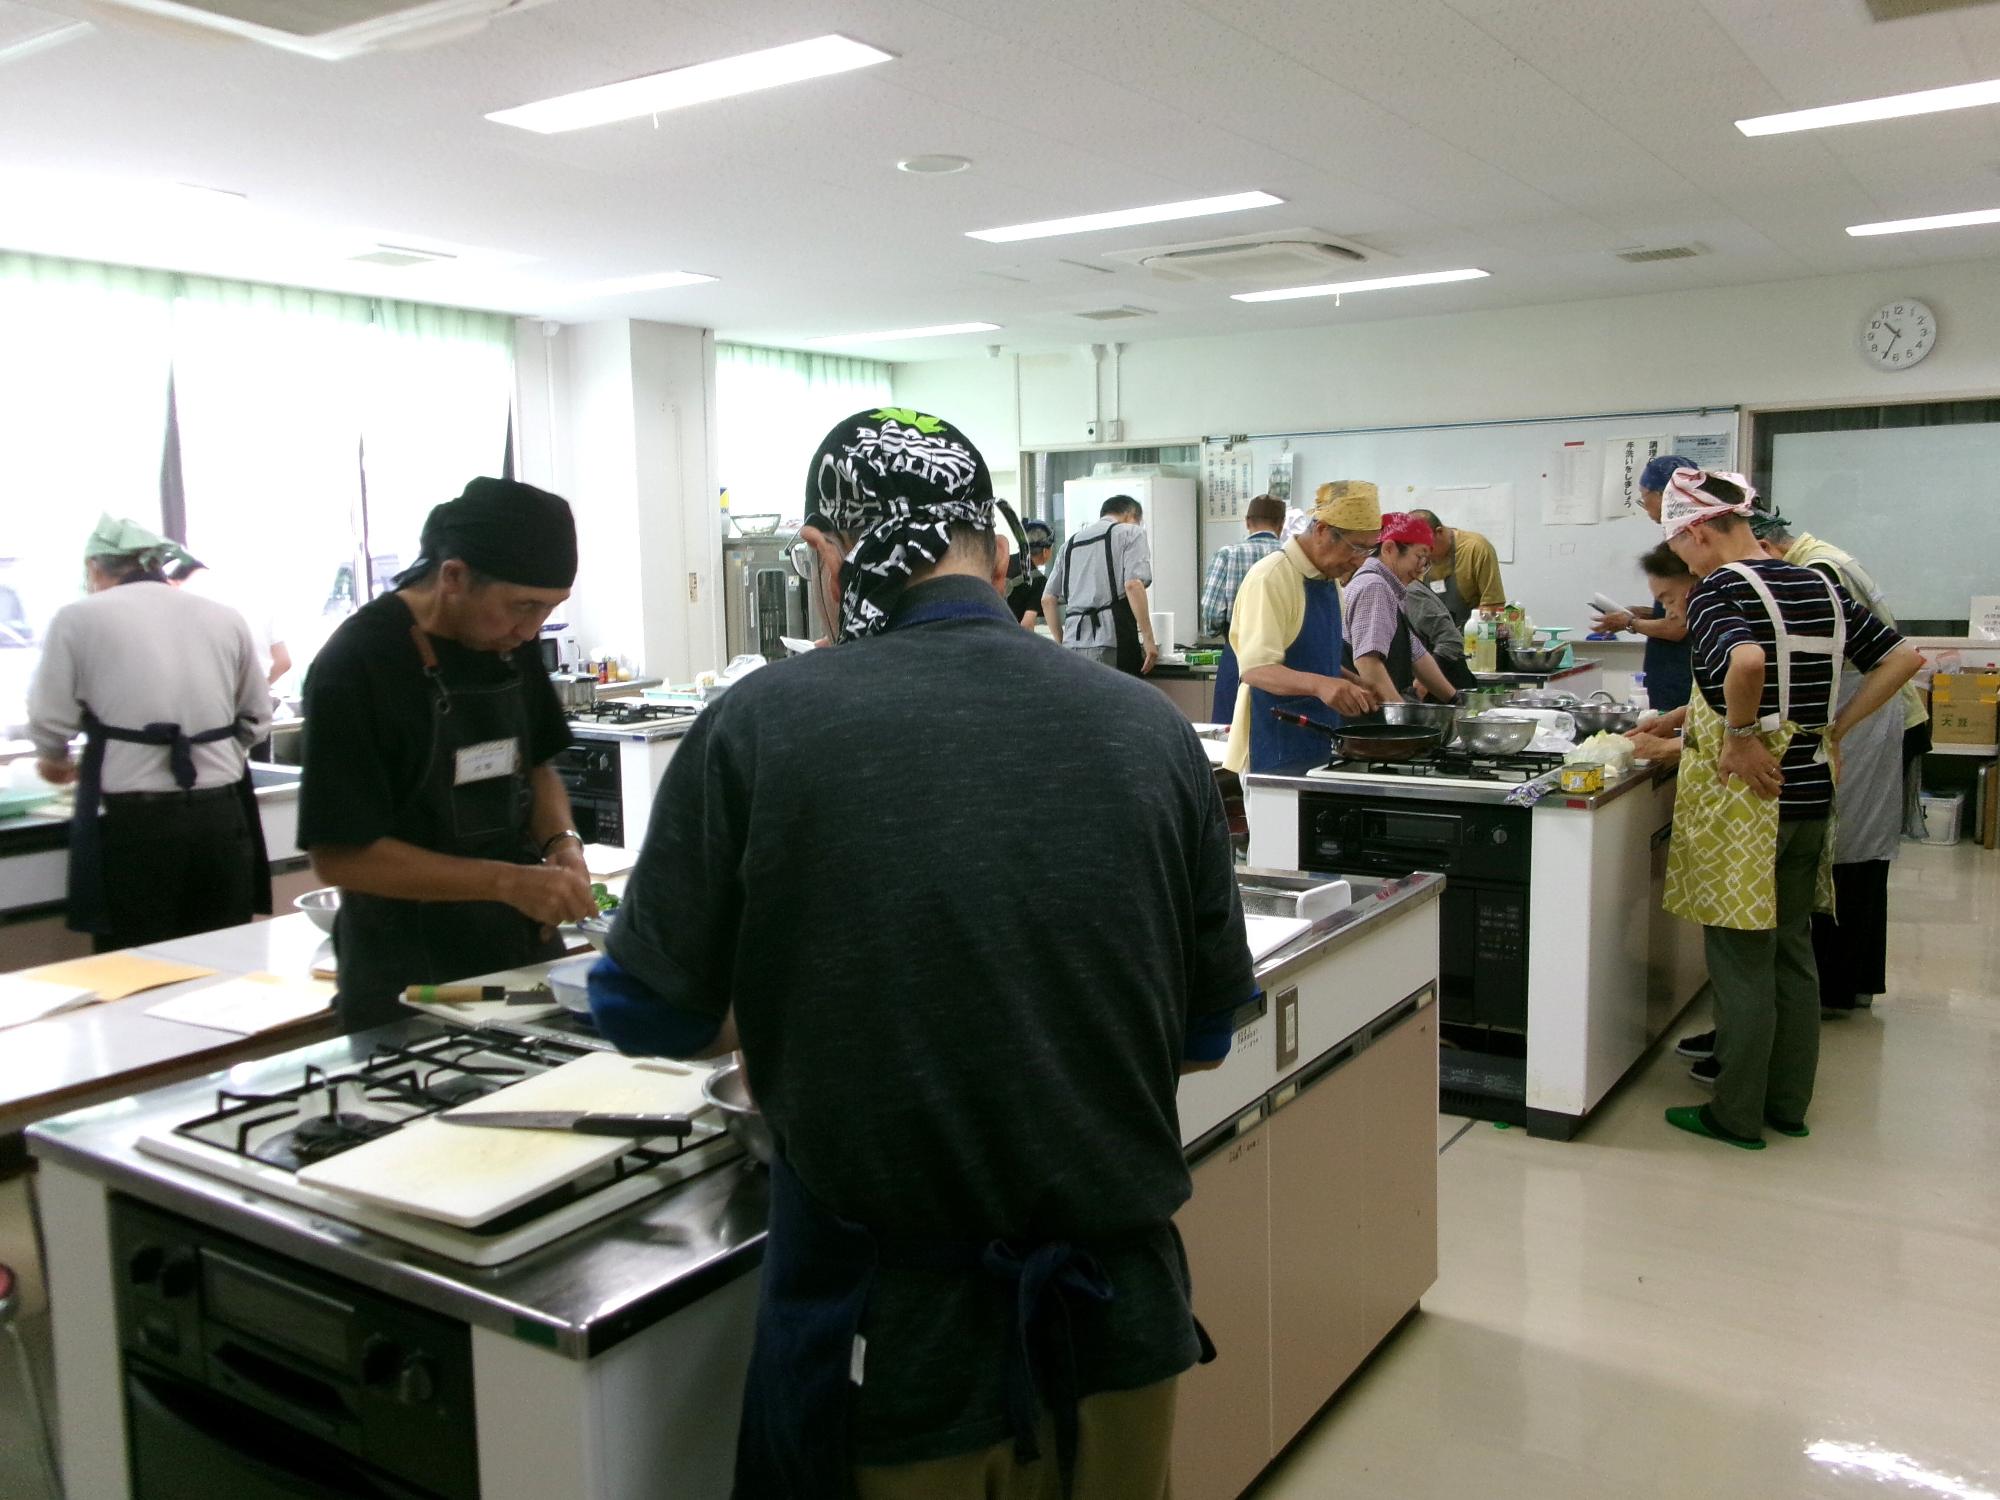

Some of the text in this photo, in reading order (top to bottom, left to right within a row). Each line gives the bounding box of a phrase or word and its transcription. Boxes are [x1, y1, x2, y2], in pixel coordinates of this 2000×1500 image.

[1894, 305, 1903, 315] 12
[1881, 311, 1889, 319] 11
[1872, 320, 1881, 329] 10
[1918, 316, 1924, 325] 2
[1921, 328, 1928, 337] 3
[1868, 333, 1874, 341] 9
[1872, 344, 1878, 352] 8
[1916, 341, 1922, 349] 4
[1893, 353, 1899, 361] 6
[1907, 350, 1913, 358] 5
